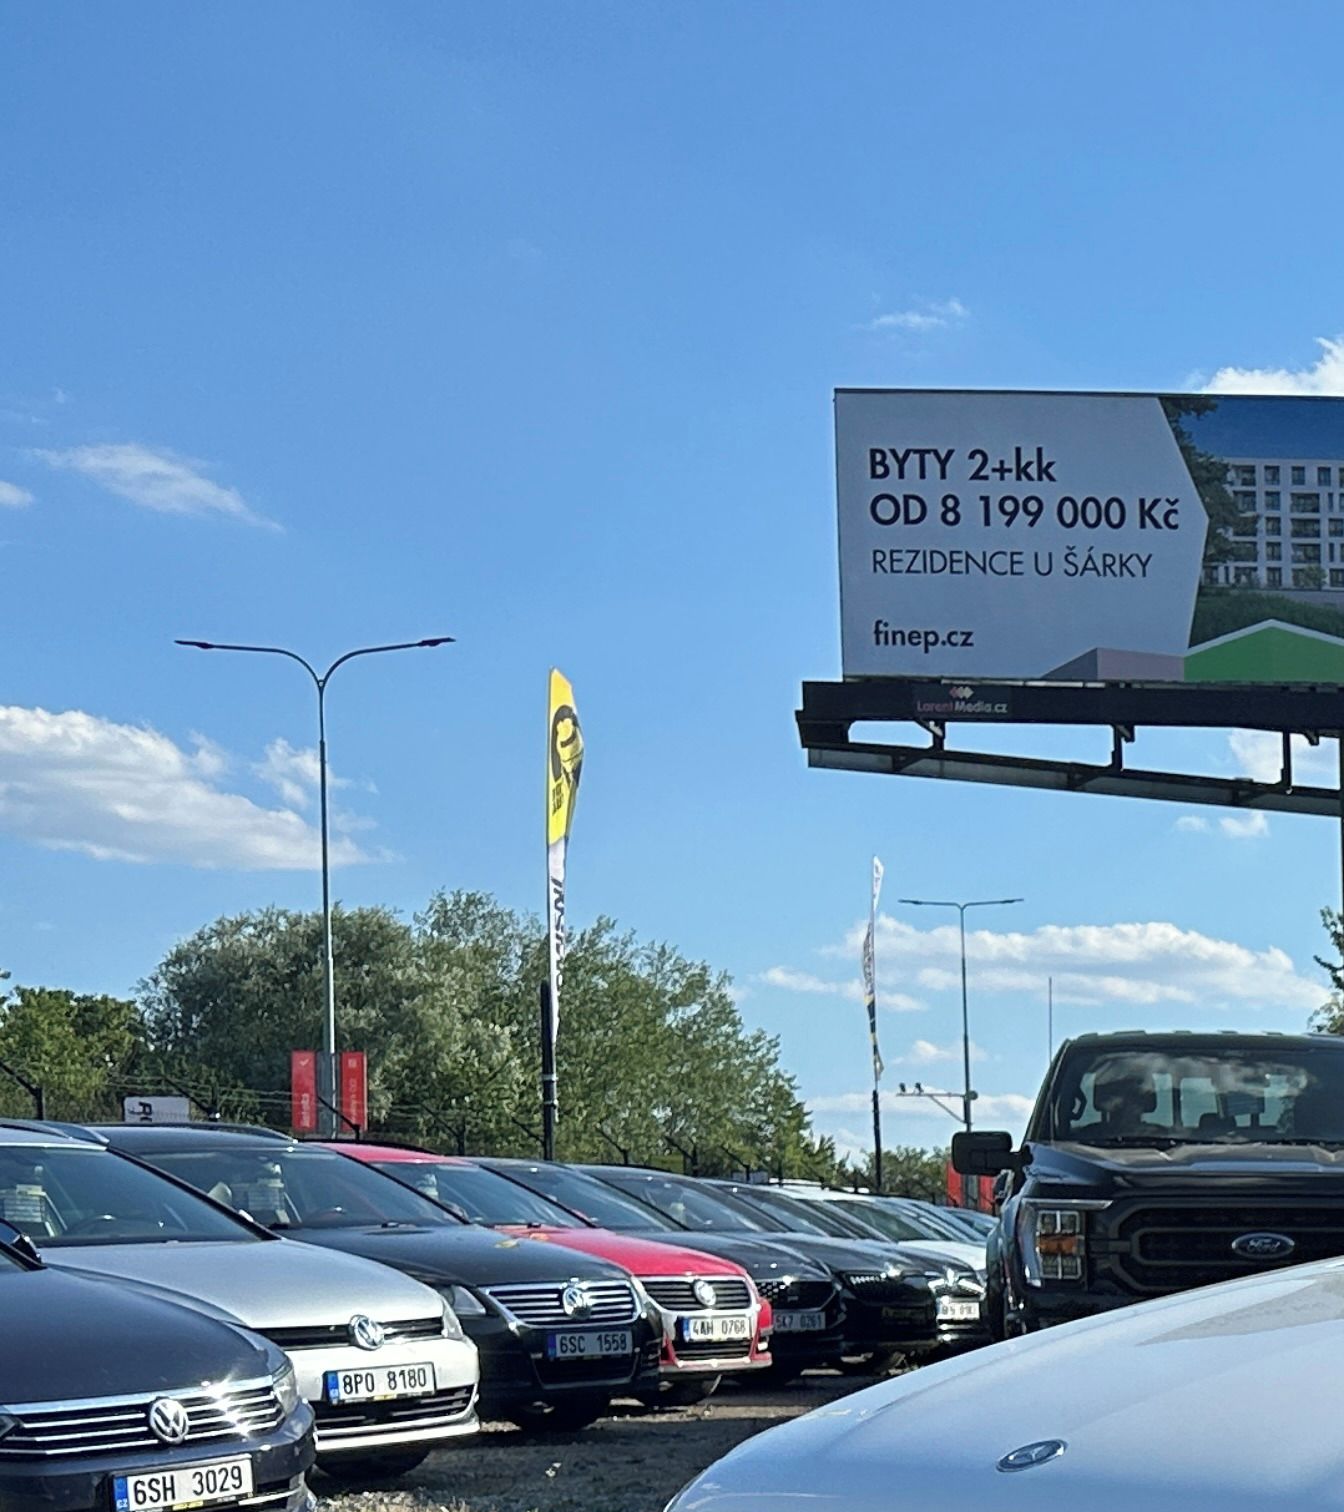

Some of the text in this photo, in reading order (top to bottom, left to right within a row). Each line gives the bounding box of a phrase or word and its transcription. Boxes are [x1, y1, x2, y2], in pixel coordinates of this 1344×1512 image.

[869, 447, 1057, 482] BYTY 2+kk
[870, 493, 1179, 530] OD 8 199 000 Kč
[872, 545, 1153, 578] REZIDENCE U ŠÁRKY
[873, 619, 975, 654] finep.cz
[559, 1335, 585, 1353] 6SC
[387, 1368, 426, 1391] 8180
[133, 1474, 176, 1505] 6SH
[192, 1465, 243, 1496] 3029
